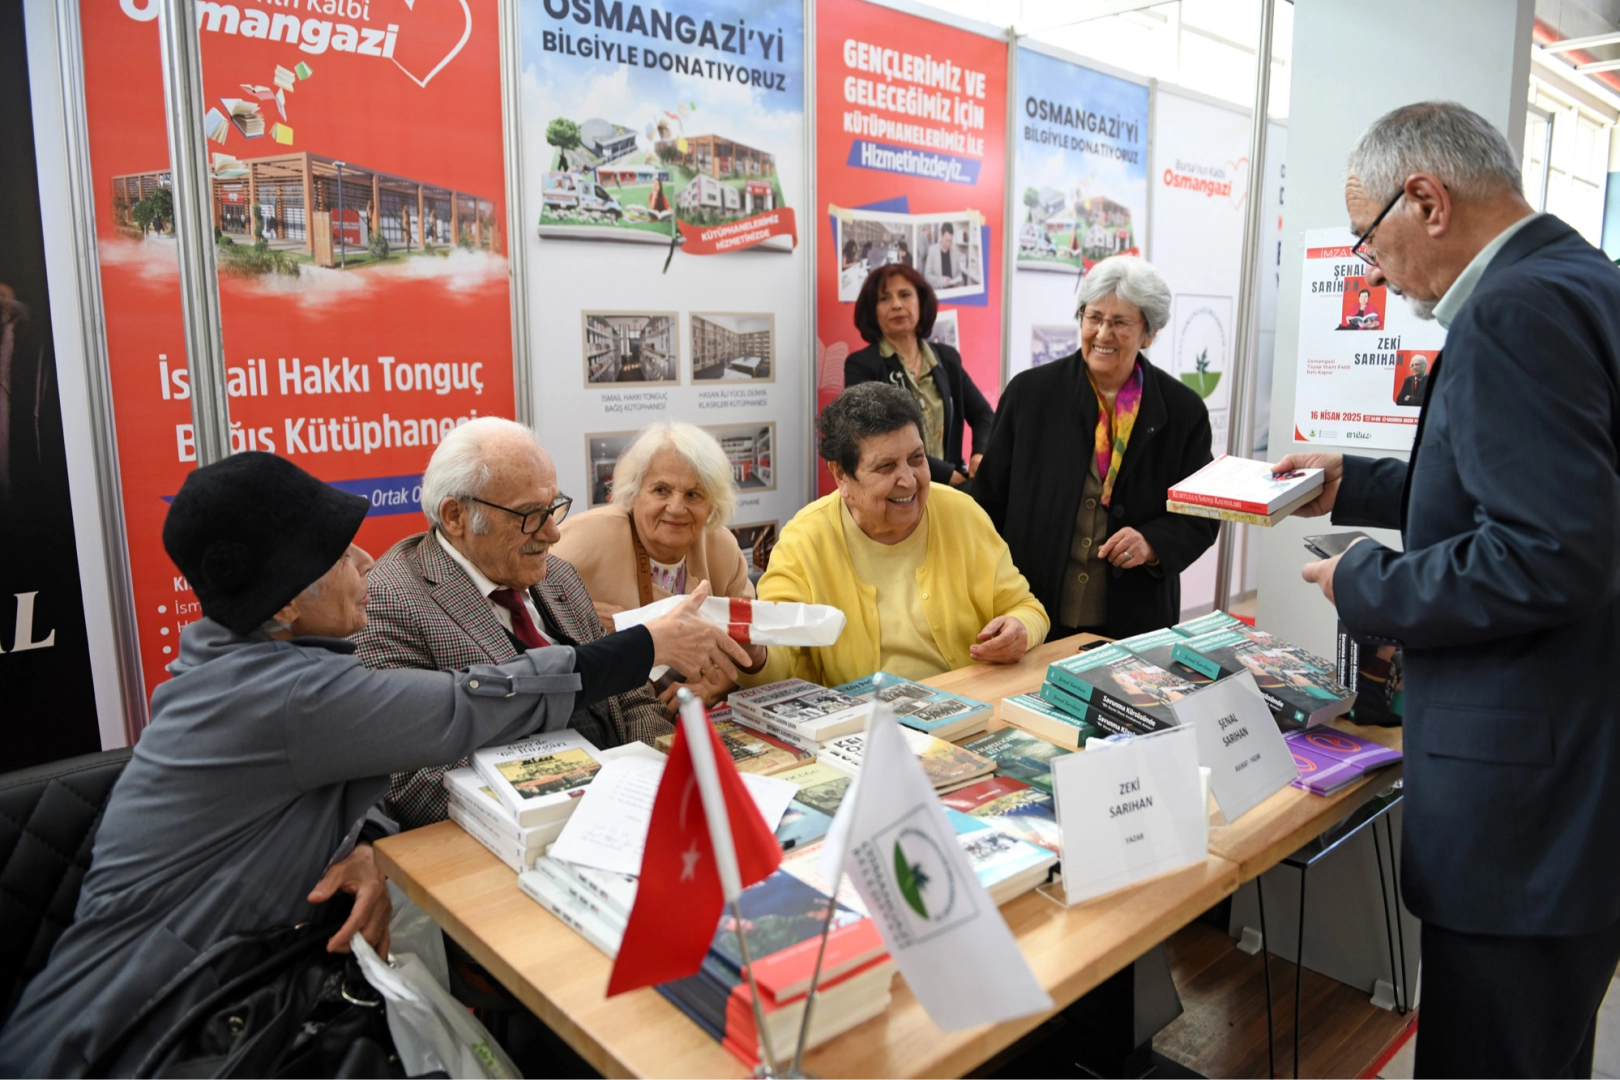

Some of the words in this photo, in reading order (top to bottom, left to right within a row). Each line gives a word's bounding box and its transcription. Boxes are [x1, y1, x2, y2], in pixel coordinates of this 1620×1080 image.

[119, 0, 399, 59] Omangazi
[542, 27, 638, 66] BİLGİYLE
[643, 49, 786, 92] DONATIYORUZ
[843, 38, 962, 93] GENÇLERİMİZ
[964, 69, 986, 99] VE
[844, 76, 951, 123] GELECEĞİMİZ
[954, 96, 985, 131] İÇİN
[1026, 96, 1139, 144] OSMANGAZİ'Yİ
[843, 110, 965, 153] KÜTÜPHANELERİMİZ
[966, 134, 985, 157] İLE
[1024, 123, 1069, 149] BİLGİYLE
[1070, 137, 1139, 165] DONATIYORUZ
[861, 141, 971, 182] Hizmetinizdeyiz...
[1163, 168, 1233, 197] Osmangazi
[701, 214, 779, 242] KÜTÜPHANELERİMİZ
[715, 229, 771, 250] HİZMETİNİZDE
[1320, 247, 1348, 258] İMZA
[1334, 264, 1366, 281] ŞENAL
[1377, 335, 1402, 350] ZEKİ
[1354, 353, 1404, 366] SARIHAN
[158, 353, 269, 400] İsail
[278, 357, 370, 396] Hakkı
[377, 356, 485, 396] Tonguç
[623, 393, 642, 401] HAKKI
[642, 392, 668, 402] TONGUÇ
[624, 402, 666, 412] KÜTÜPHANESİ
[1310, 411, 1319, 420] 16
[1320, 409, 1341, 421] NİSAN
[1342, 412, 1362, 422] 2025
[372, 487, 409, 507] Ortak
[1102, 695, 1126, 712] Savunma
[1126, 707, 1156, 727] Kürsüsünde
[1097, 714, 1121, 731] Savunma
[1218, 713, 1239, 731] ŞENAL
[1222, 726, 1249, 747] SARIHAN
[1119, 776, 1140, 795] ZEKİ
[1109, 796, 1153, 819] SARIHAN
[1125, 833, 1144, 844] YAZAR
